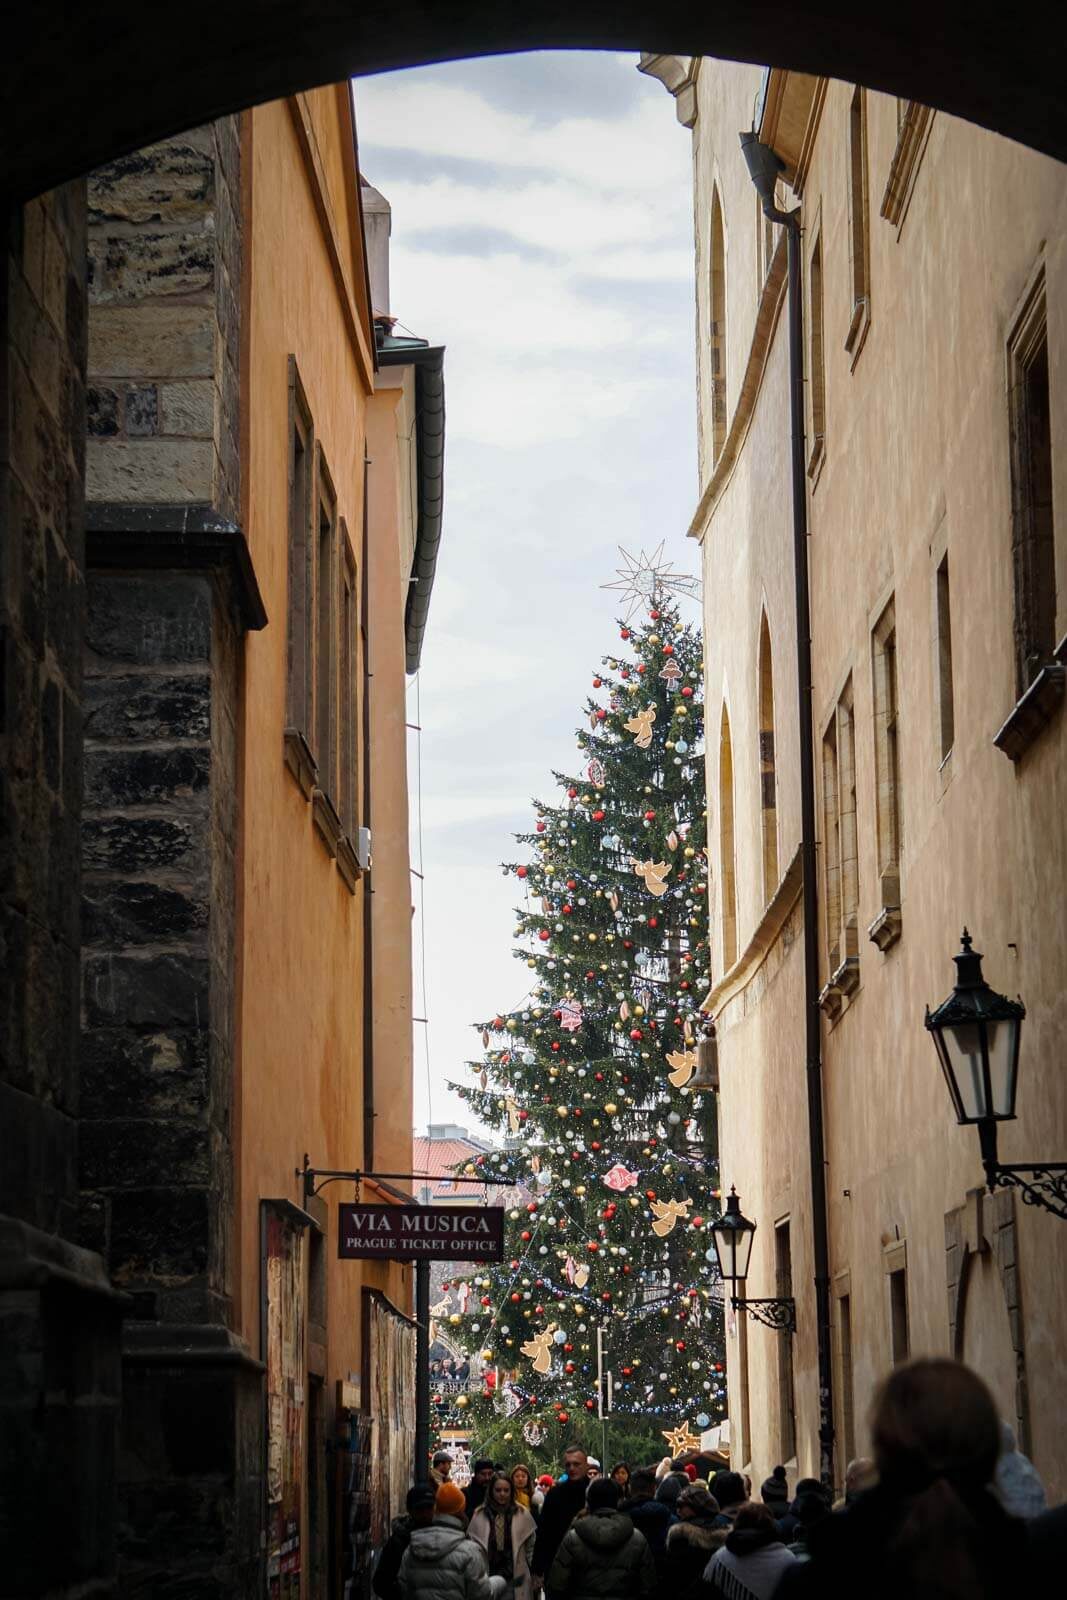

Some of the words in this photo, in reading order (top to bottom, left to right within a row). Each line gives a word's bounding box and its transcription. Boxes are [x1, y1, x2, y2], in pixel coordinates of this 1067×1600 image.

[352, 1213, 392, 1231] VIA
[401, 1215, 490, 1233] MUSICA
[346, 1237, 397, 1249] PRAGUE
[400, 1238, 447, 1250] TICKET
[451, 1240, 497, 1251] OFFICE
